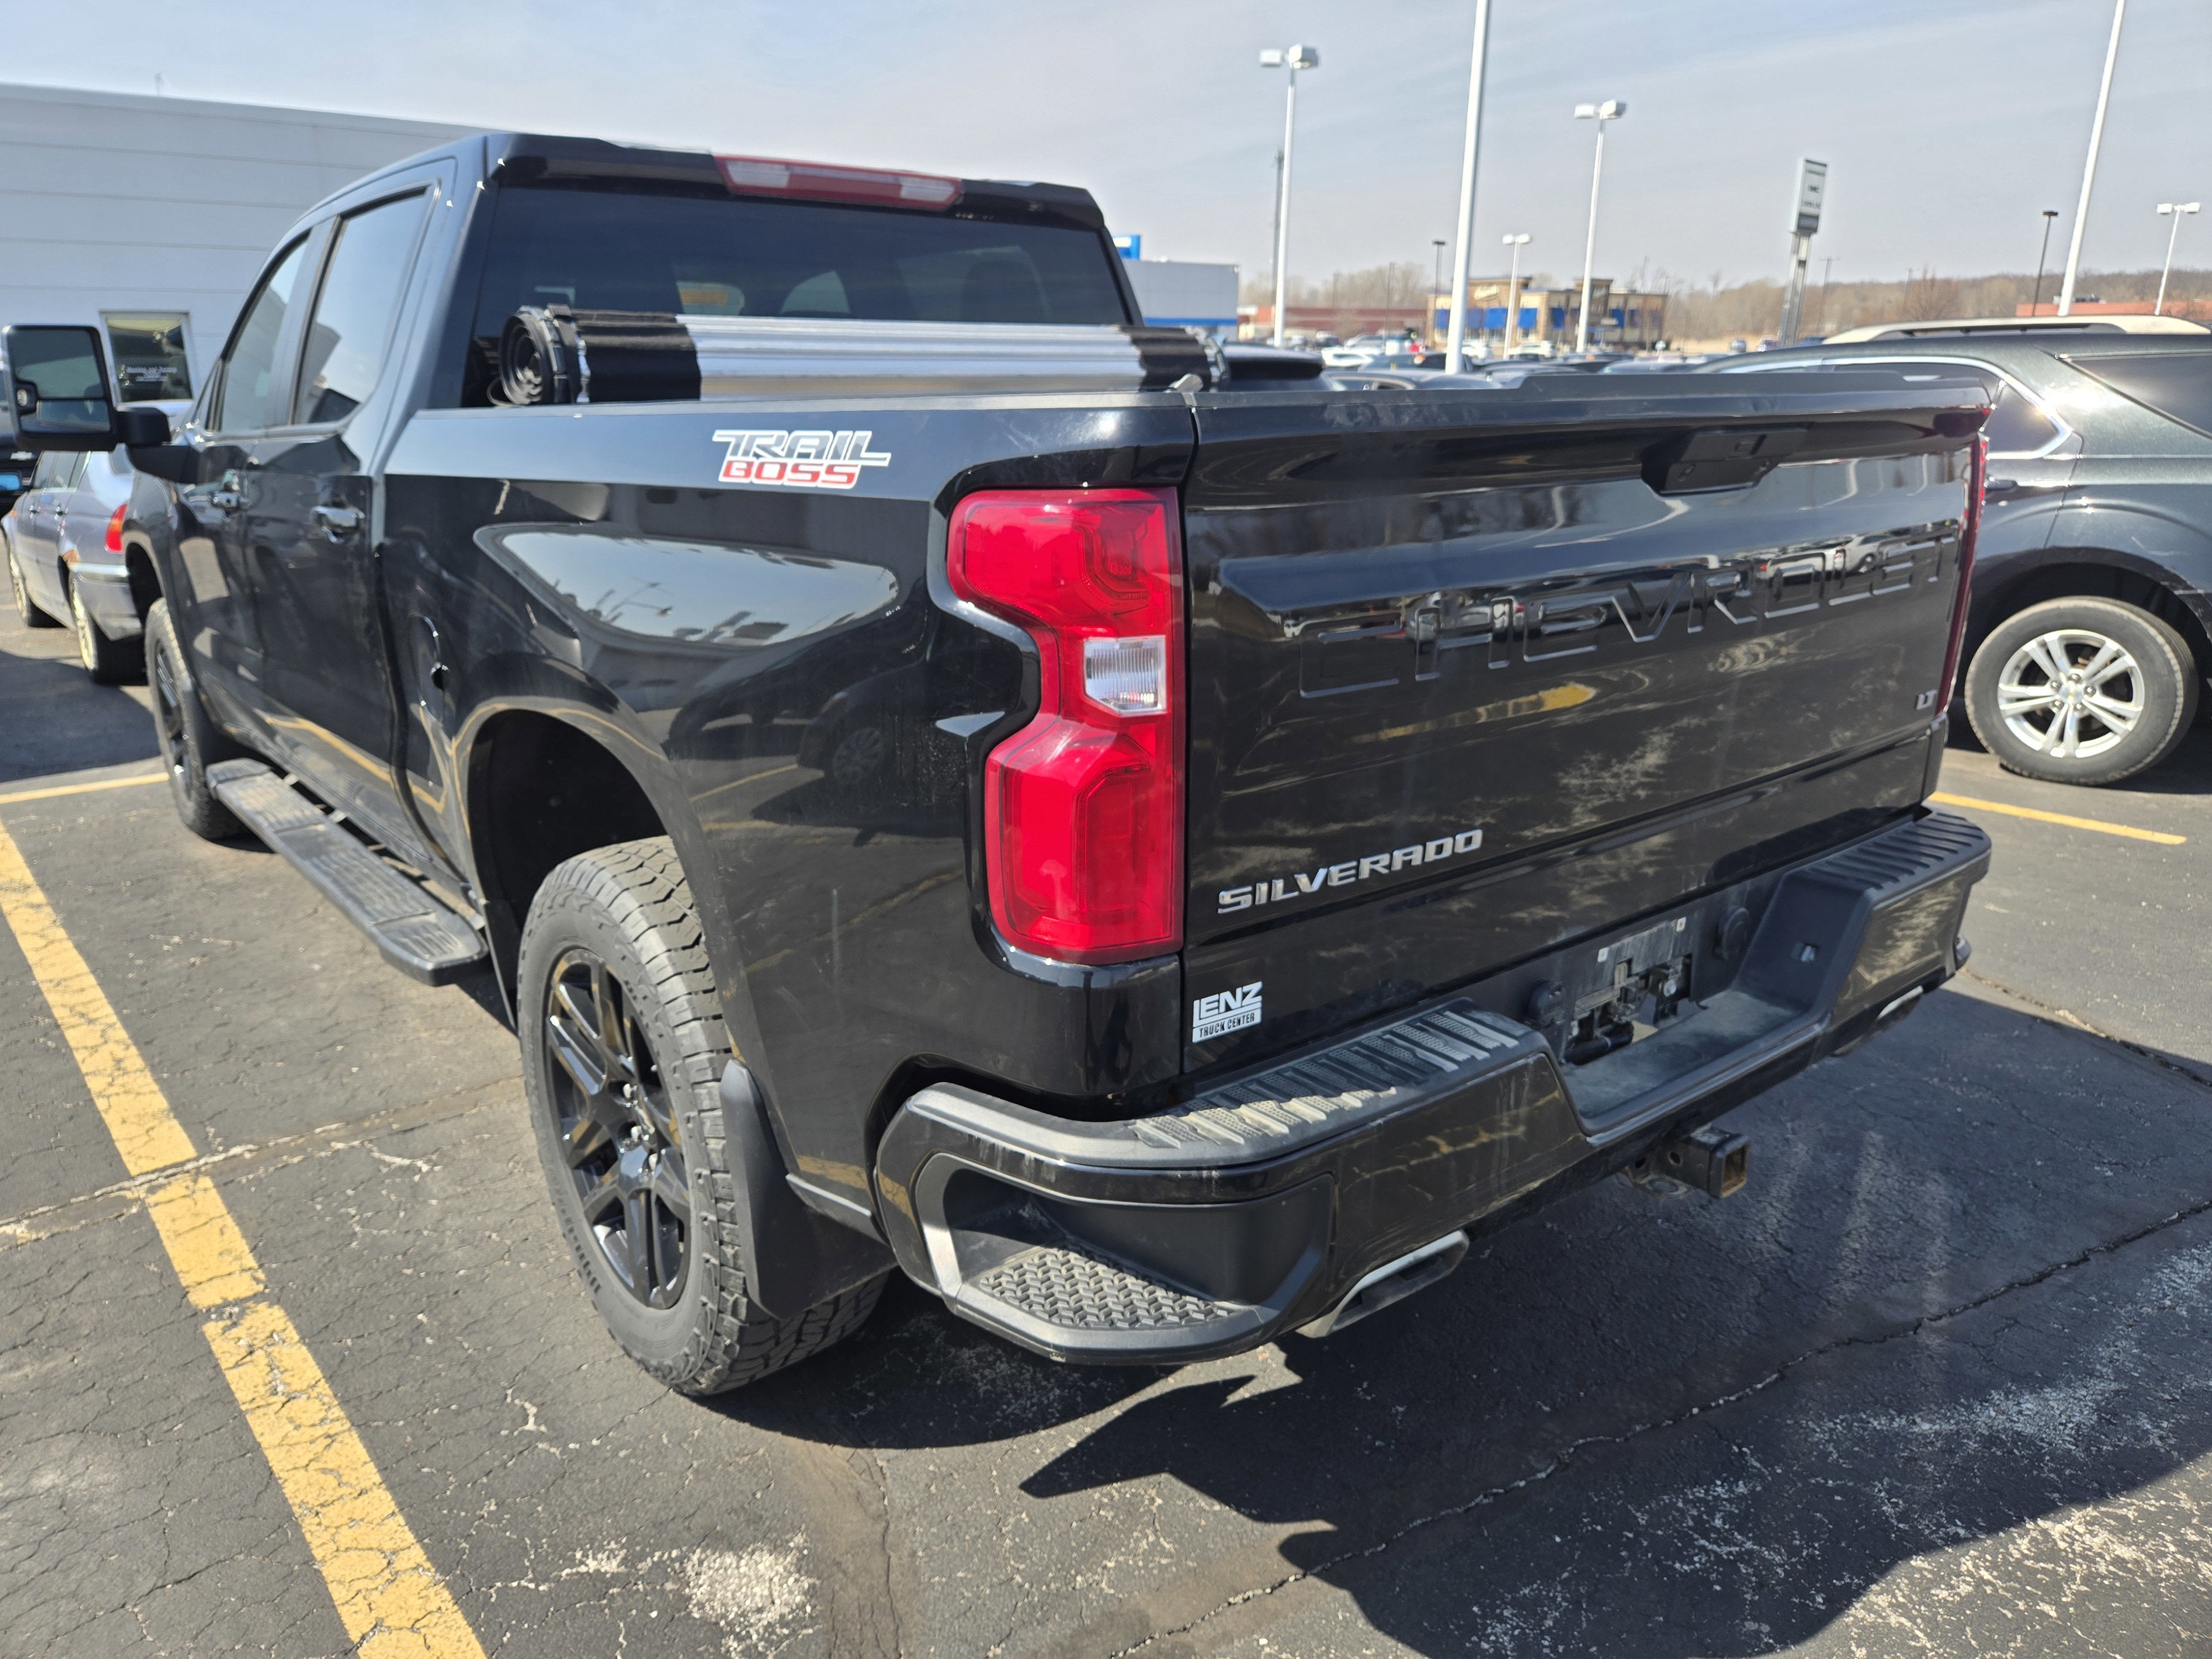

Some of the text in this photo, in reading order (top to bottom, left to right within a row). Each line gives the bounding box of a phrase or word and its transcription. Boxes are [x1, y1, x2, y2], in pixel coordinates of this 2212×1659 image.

[712, 430, 891, 466] TRAIL
[718, 458, 861, 489] BOSS
[1300, 532, 1959, 698] CHEVROLET
[1916, 688, 1937, 711] LT
[1218, 829, 1483, 914] SILVERADO
[1192, 981, 1262, 1027] LENZ
[1199, 1012, 1255, 1038] TRUCK CENTER
